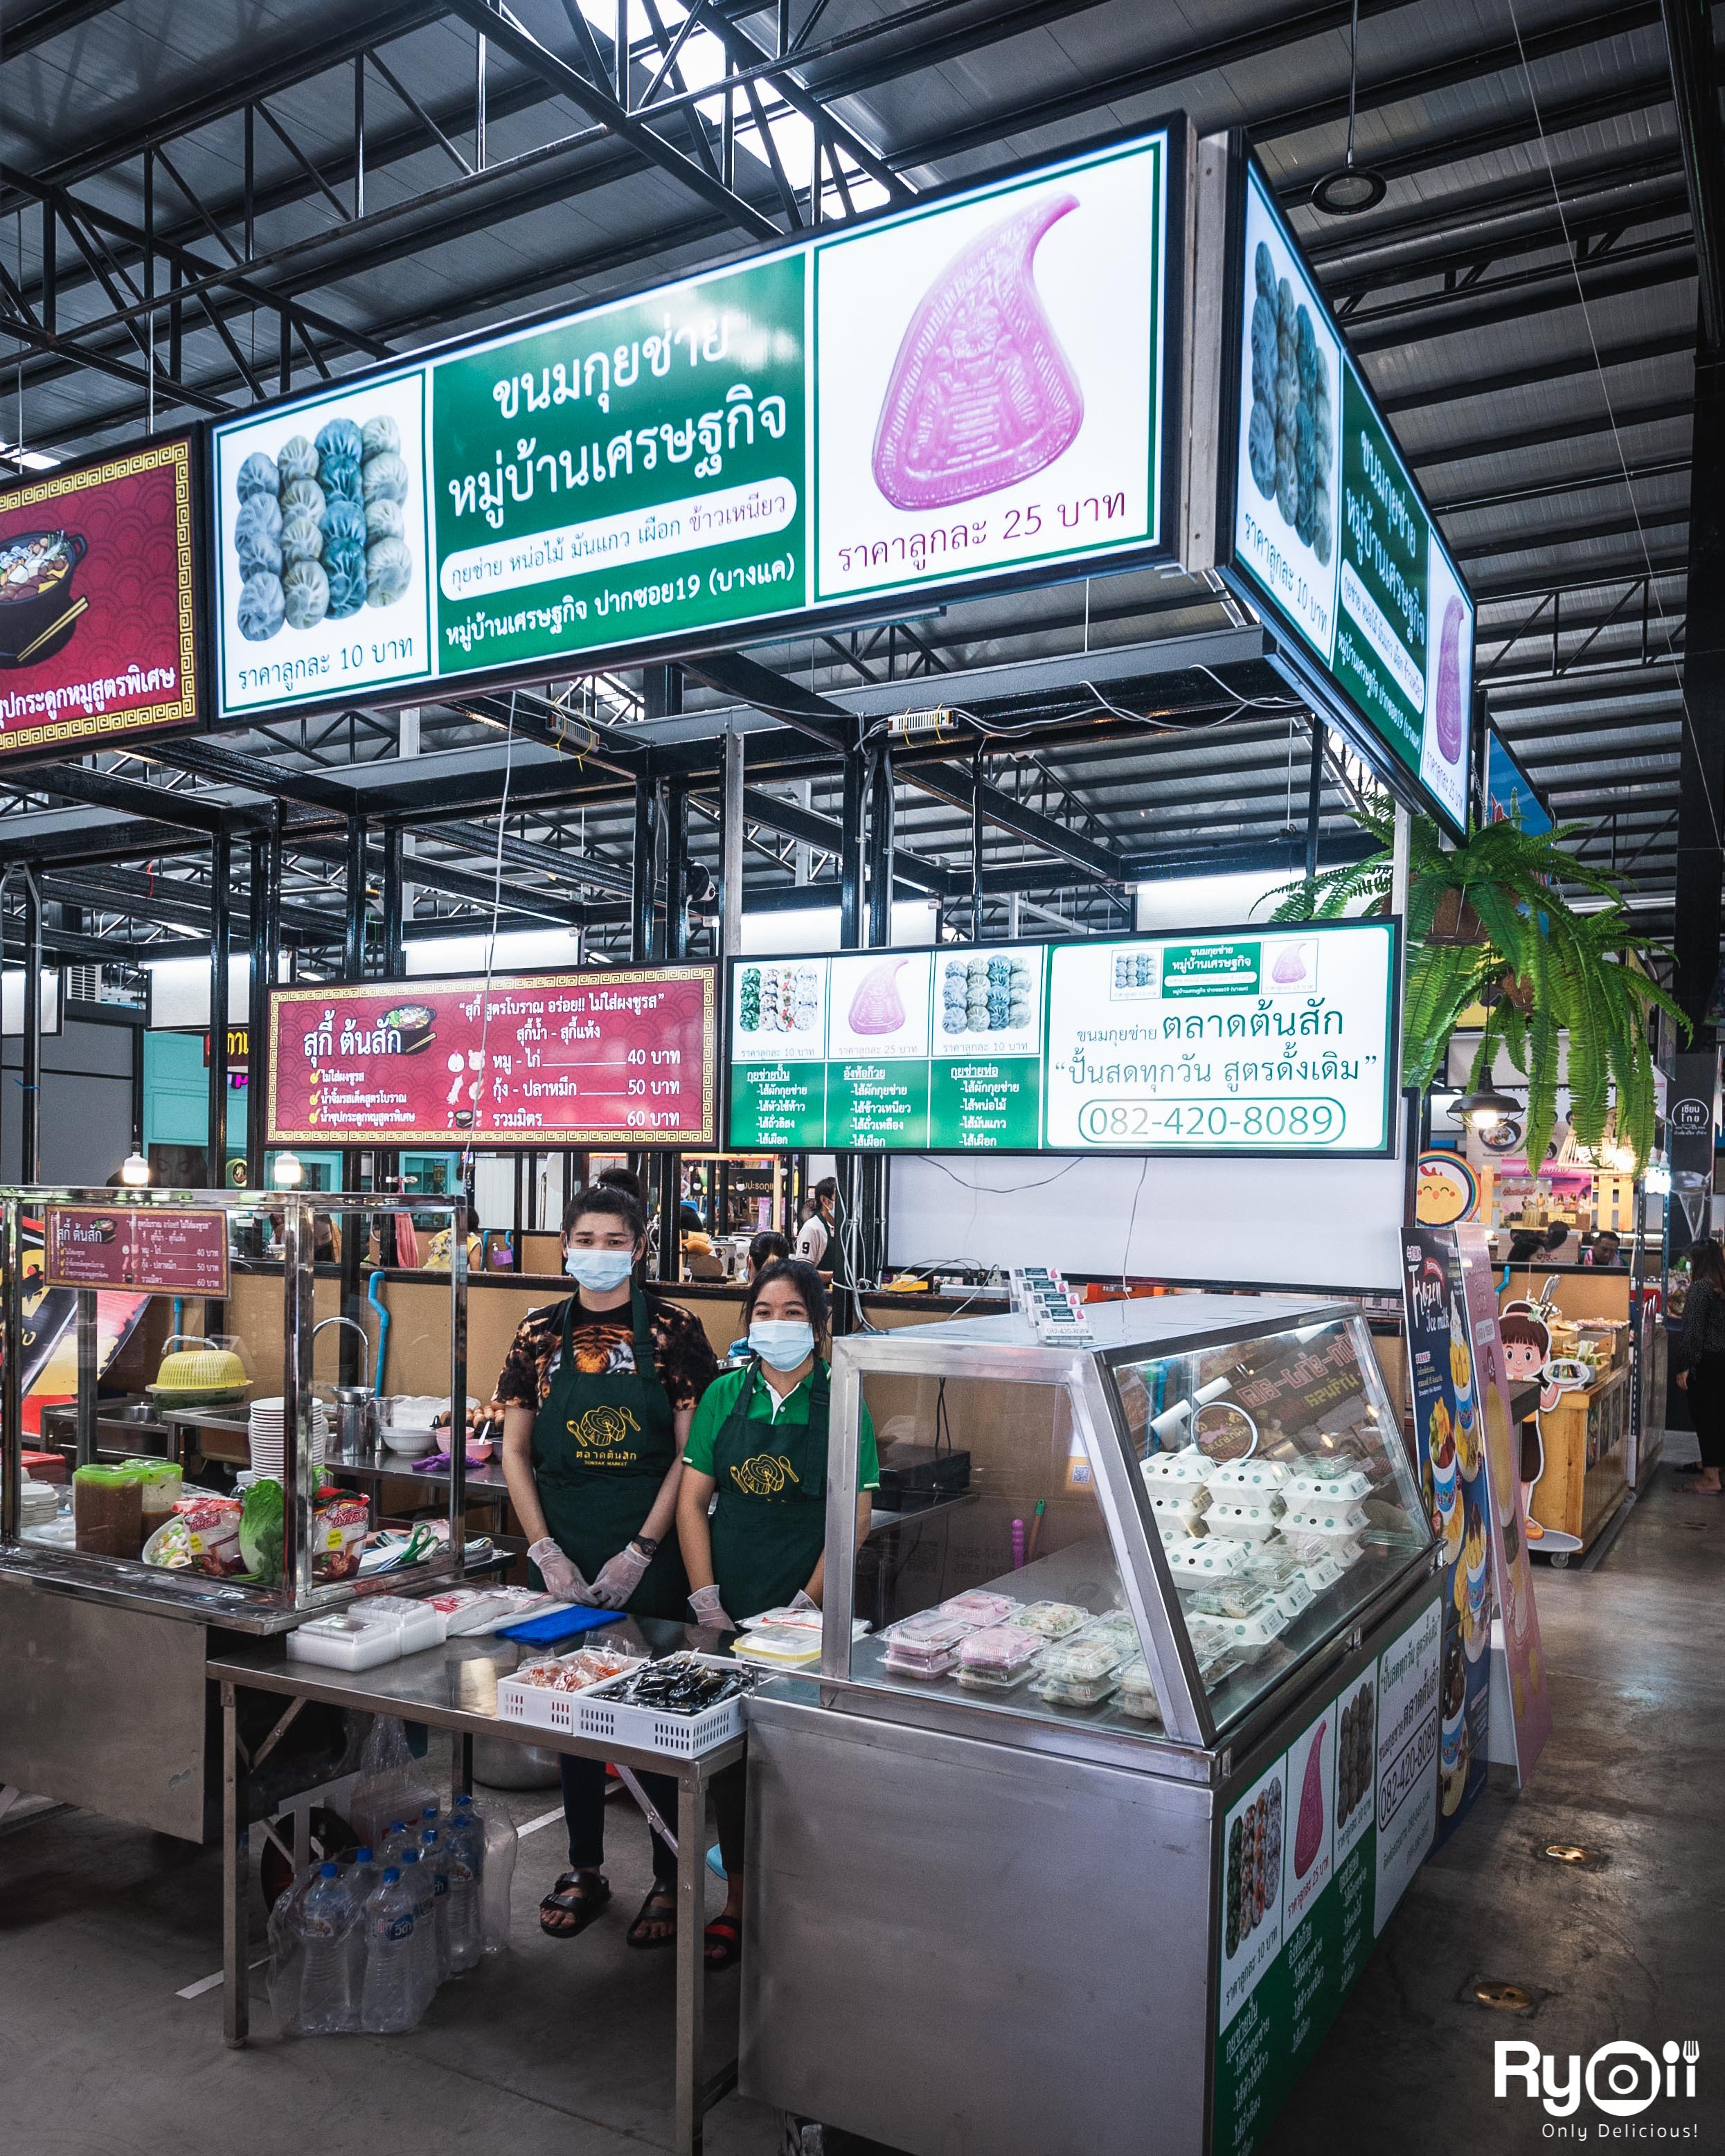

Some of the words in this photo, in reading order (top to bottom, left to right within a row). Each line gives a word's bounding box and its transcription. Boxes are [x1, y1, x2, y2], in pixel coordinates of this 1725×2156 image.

[492, 313, 730, 418] ขนมกุยช่าย
[449, 384, 786, 529] หมู่บ้านเศรษฐกิจ
[1361, 431, 1415, 557] ขนมกุยช่าย
[451, 556, 503, 589] กุยช่าย
[510, 538, 564, 573] หน่อไม้
[571, 528, 631, 559] มันแกว
[638, 517, 681, 544] เผือก
[689, 493, 786, 532] ข้าวเหนียว
[839, 521, 987, 571] ราคาลูกละ
[1003, 504, 1041, 539] 25
[1057, 492, 1125, 528] บาท
[1245, 513, 1294, 591] ราคาลูกละ
[1297, 577, 1307, 610] 10
[1311, 596, 1327, 636] บาท
[1346, 487, 1424, 645] หมู่บ้านเศรษฐกิจ
[445, 595, 587, 652] หมู่บ้านเศรษฐกิจ
[595, 574, 700, 616] ปากซอย19
[708, 553, 795, 595] (บางแค)
[238, 656, 330, 690] ราคาลูกละ
[341, 645, 364, 670] 10
[373, 636, 413, 662] บาท
[486, 997, 544, 1022] สูตรโบราณ
[548, 997, 585, 1014] อร่อย!!
[516, 1017, 547, 1046] สุกี้น้ำ
[560, 1015, 600, 1045] สุกี้แห้ง
[1078, 1024, 1157, 1047] ขนมกุยช่าย
[1163, 998, 1343, 1039] ตลาดต้นสัก
[303, 1009, 335, 1068] สุกี้
[339, 1018, 402, 1056] ต้นสัก
[492, 1054, 512, 1075] หมู
[524, 1046, 541, 1068] ไก่
[627, 1049, 646, 1065] 40
[650, 1049, 681, 1066] บาท
[492, 1077, 508, 1104] กุ้ง
[522, 1075, 577, 1097] ปลาหมึก
[627, 1079, 645, 1095] 50
[650, 1079, 680, 1095] บาท
[492, 1107, 543, 1127] รวมมิตร
[627, 1110, 645, 1126] 60
[650, 1110, 680, 1127] บาท
[1089, 1106, 1333, 1135] 082-420-8089
[73, 1223, 102, 1243] ต้นสัก
[802, 1242, 810, 1254] 9
[1380, 1717, 1437, 1822] 082-420-8089
[1258, 1942, 1264, 1964] 10
[1267, 1926, 1278, 1950] บาท
